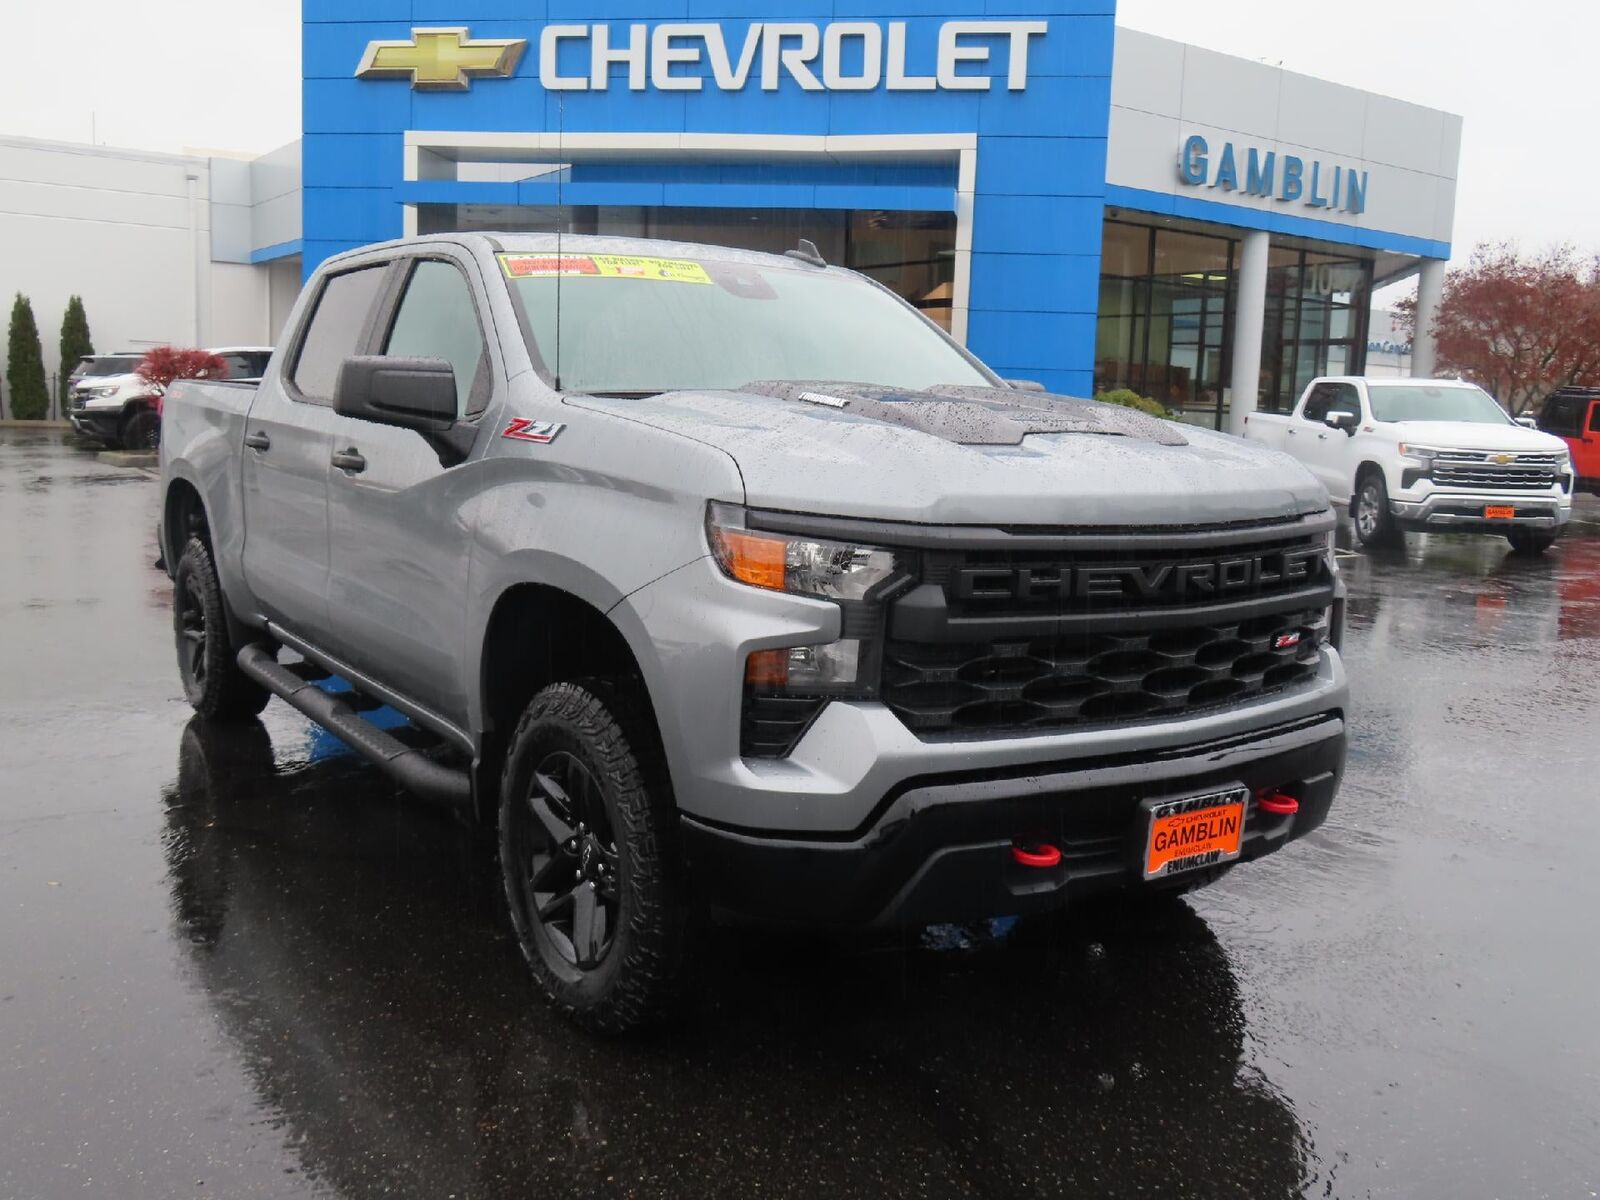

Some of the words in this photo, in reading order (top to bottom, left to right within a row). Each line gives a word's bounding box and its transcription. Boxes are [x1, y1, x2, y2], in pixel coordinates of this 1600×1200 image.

[539, 21, 1048, 91] CHEVROLET
[1180, 134, 1368, 214] GAMBLIN
[958, 547, 1324, 601] CHEVROLET
[1154, 816, 1237, 852] GAMBLIN
[1185, 809, 1228, 824] CHEVROLET
[1166, 849, 1222, 874] ENUMCLAW
